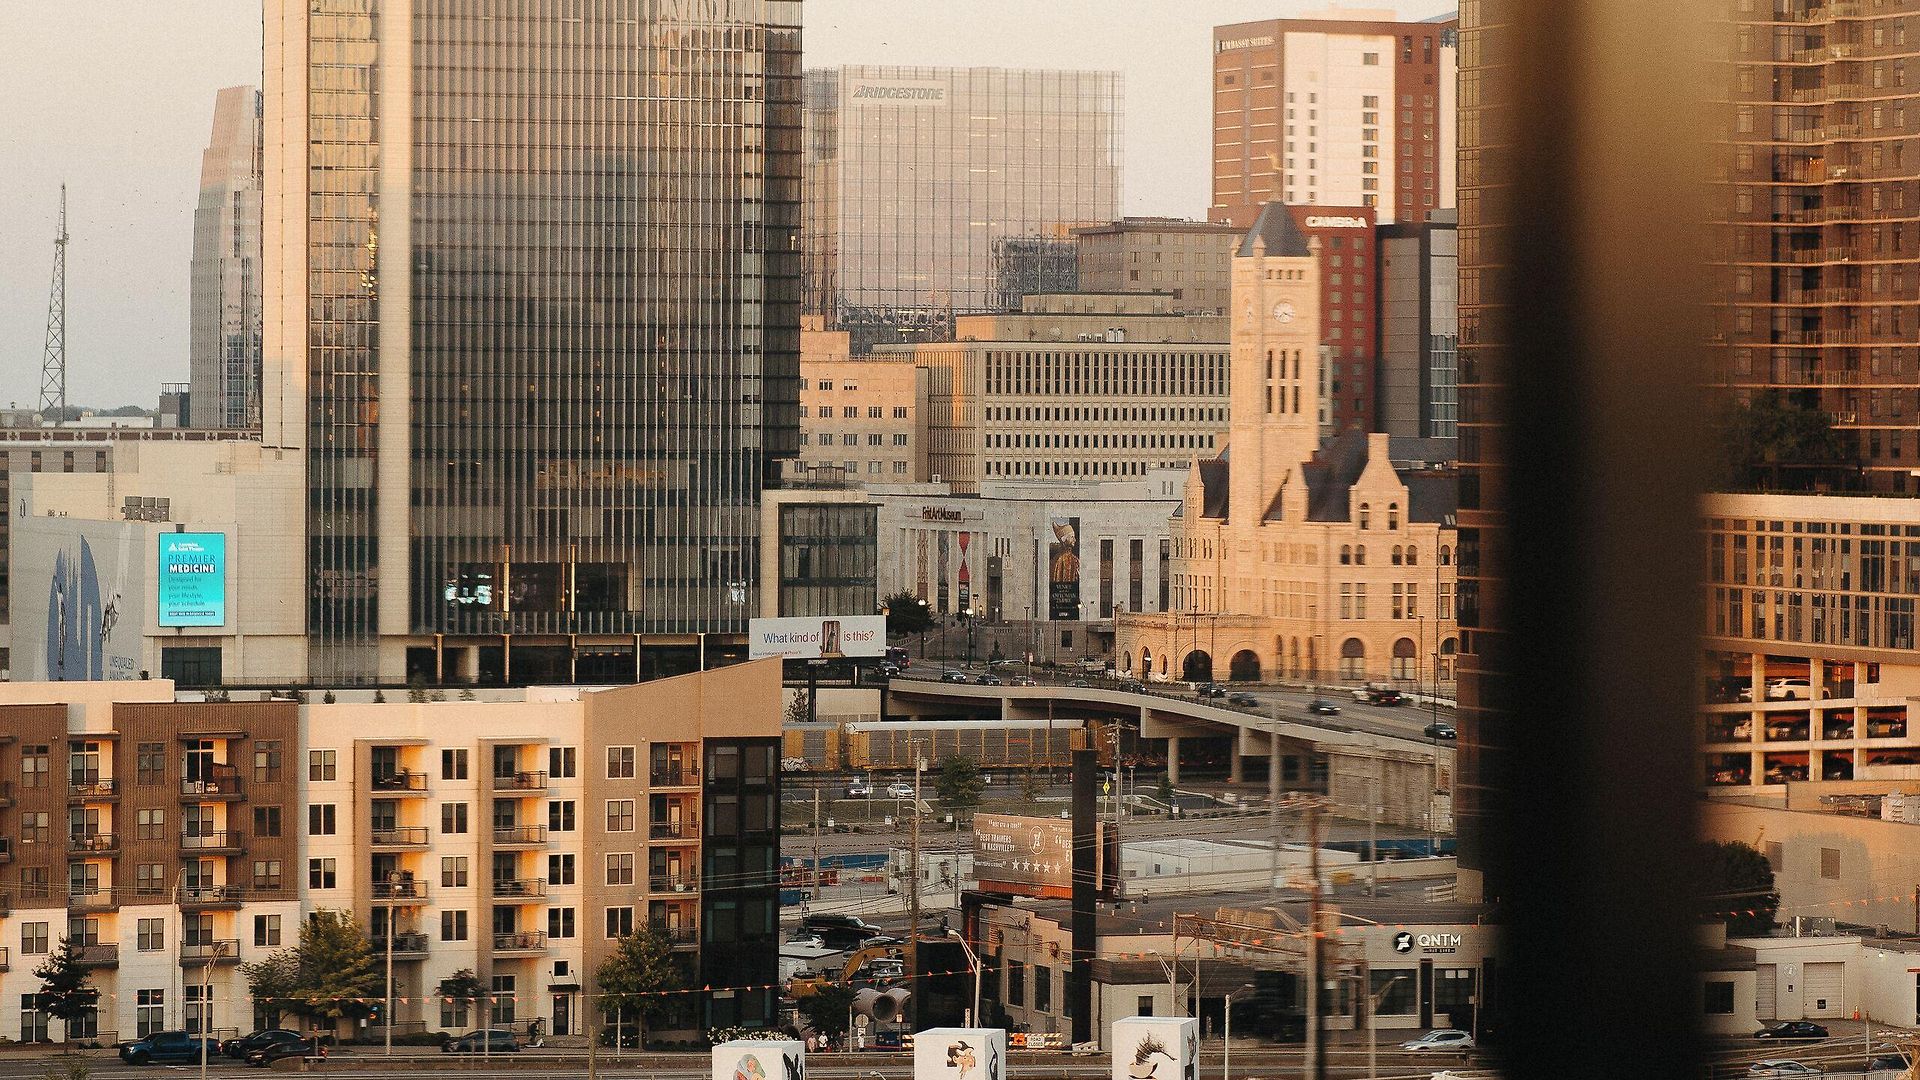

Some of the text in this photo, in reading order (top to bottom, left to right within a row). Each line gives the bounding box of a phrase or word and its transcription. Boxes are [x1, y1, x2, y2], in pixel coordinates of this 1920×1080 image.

[853, 85, 944, 100] BRIDGESTONE
[168, 554, 216, 563] PREMIER
[169, 564, 215, 573] MEDICINE
[763, 630, 875, 643] What kind of is this?
[991, 834, 1012, 843] TRAINERS
[1417, 934, 1461, 947] QNTM
